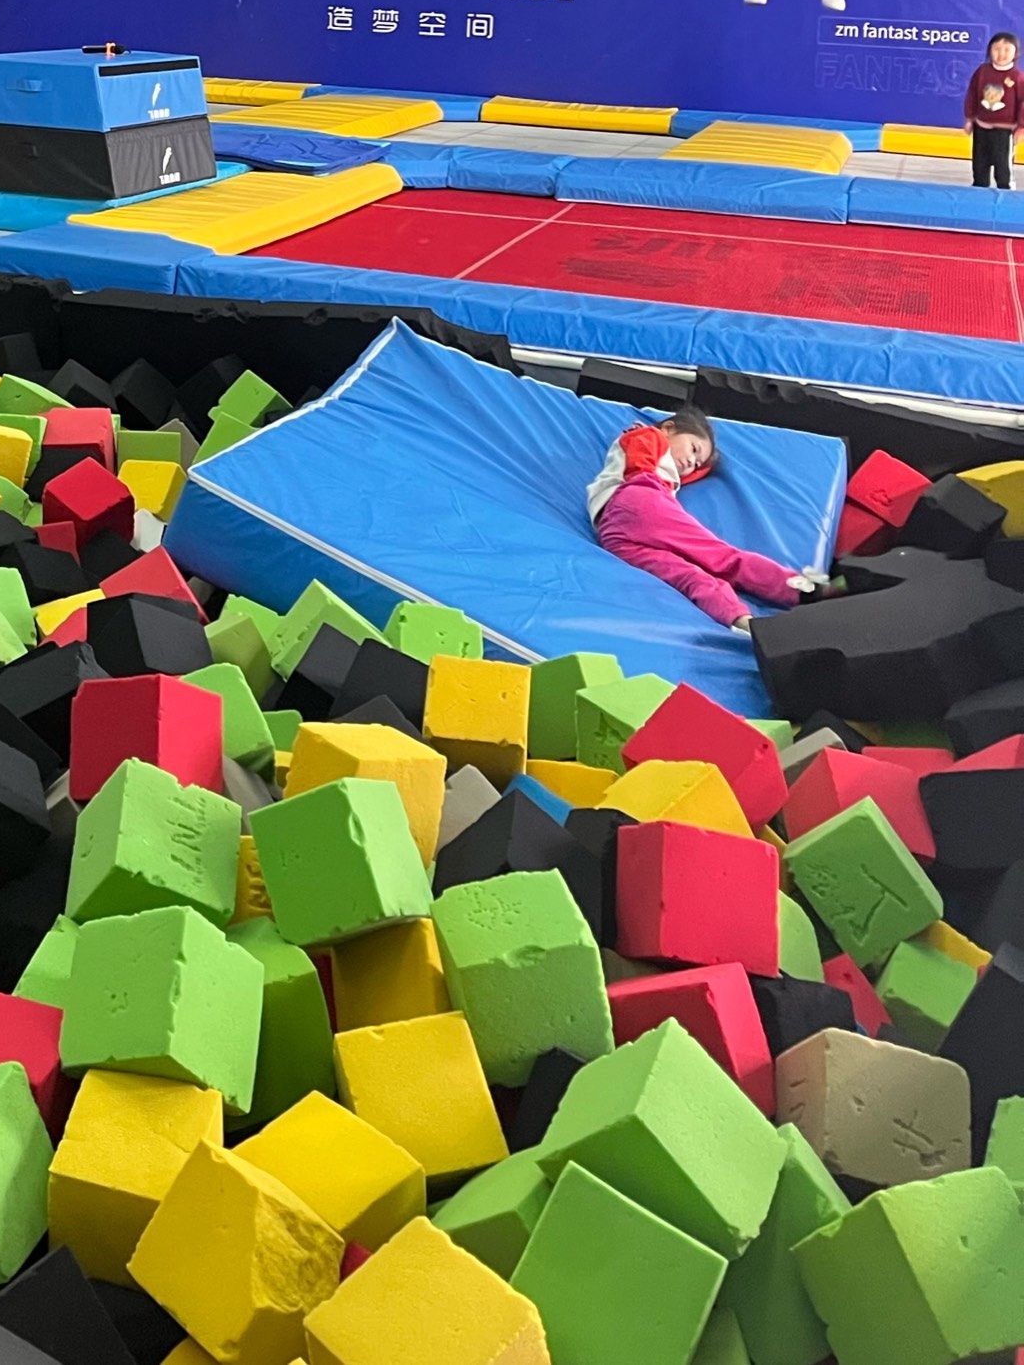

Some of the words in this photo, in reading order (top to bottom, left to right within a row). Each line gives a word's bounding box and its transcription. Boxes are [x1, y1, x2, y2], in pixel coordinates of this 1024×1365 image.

[327, 6, 494, 39] 造梦空间
[834, 24, 859, 38] zm
[862, 22, 918, 41] fantast
[921, 28, 970, 45] space
